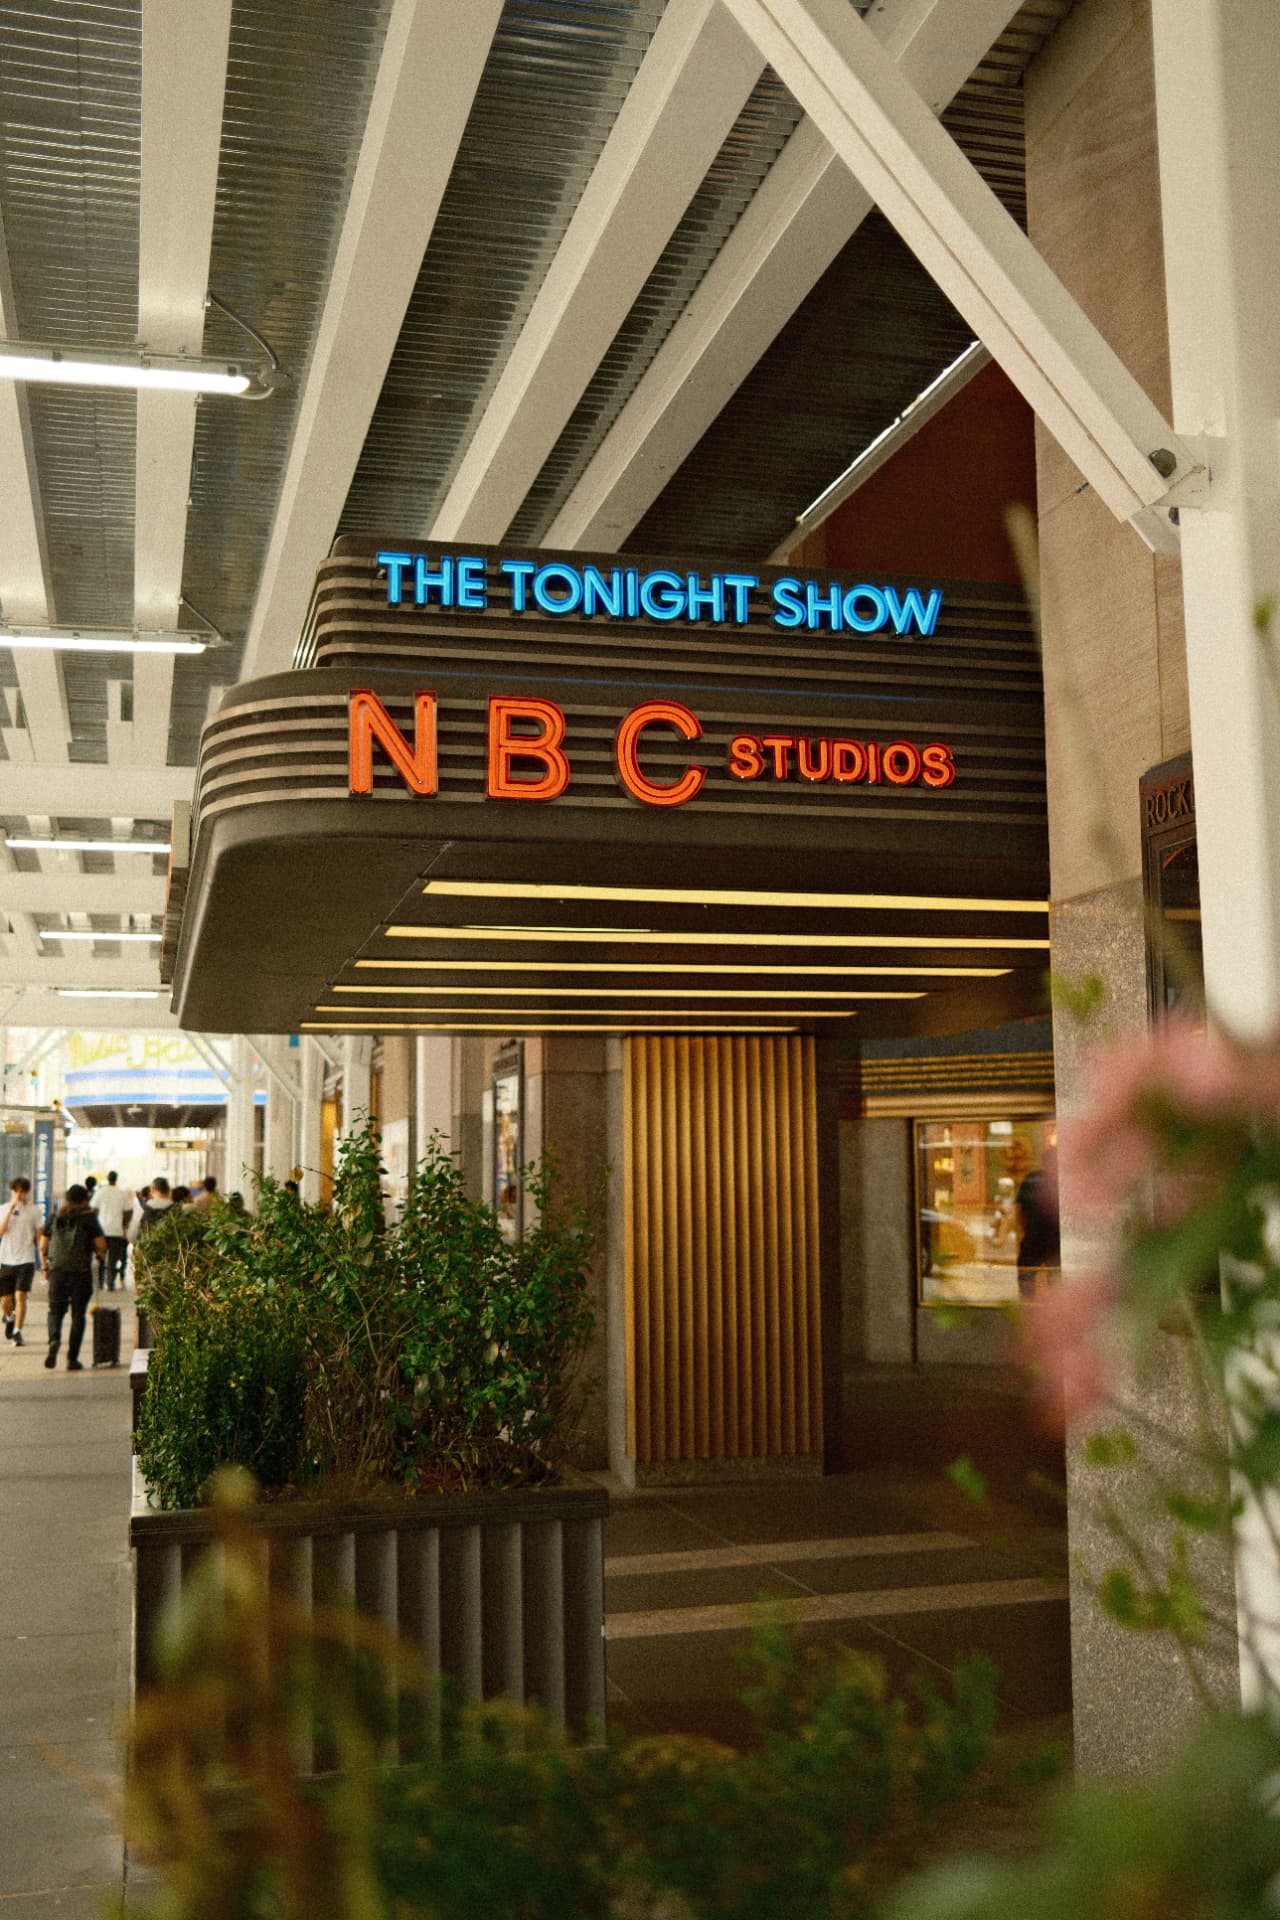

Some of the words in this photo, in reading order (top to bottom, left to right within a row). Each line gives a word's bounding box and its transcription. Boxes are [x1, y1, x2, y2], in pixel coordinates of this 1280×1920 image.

[376, 551, 487, 608] THE
[500, 559, 760, 624] TONIGHT
[771, 577, 943, 636] SHOW
[728, 734, 957, 788] STUDIOS
